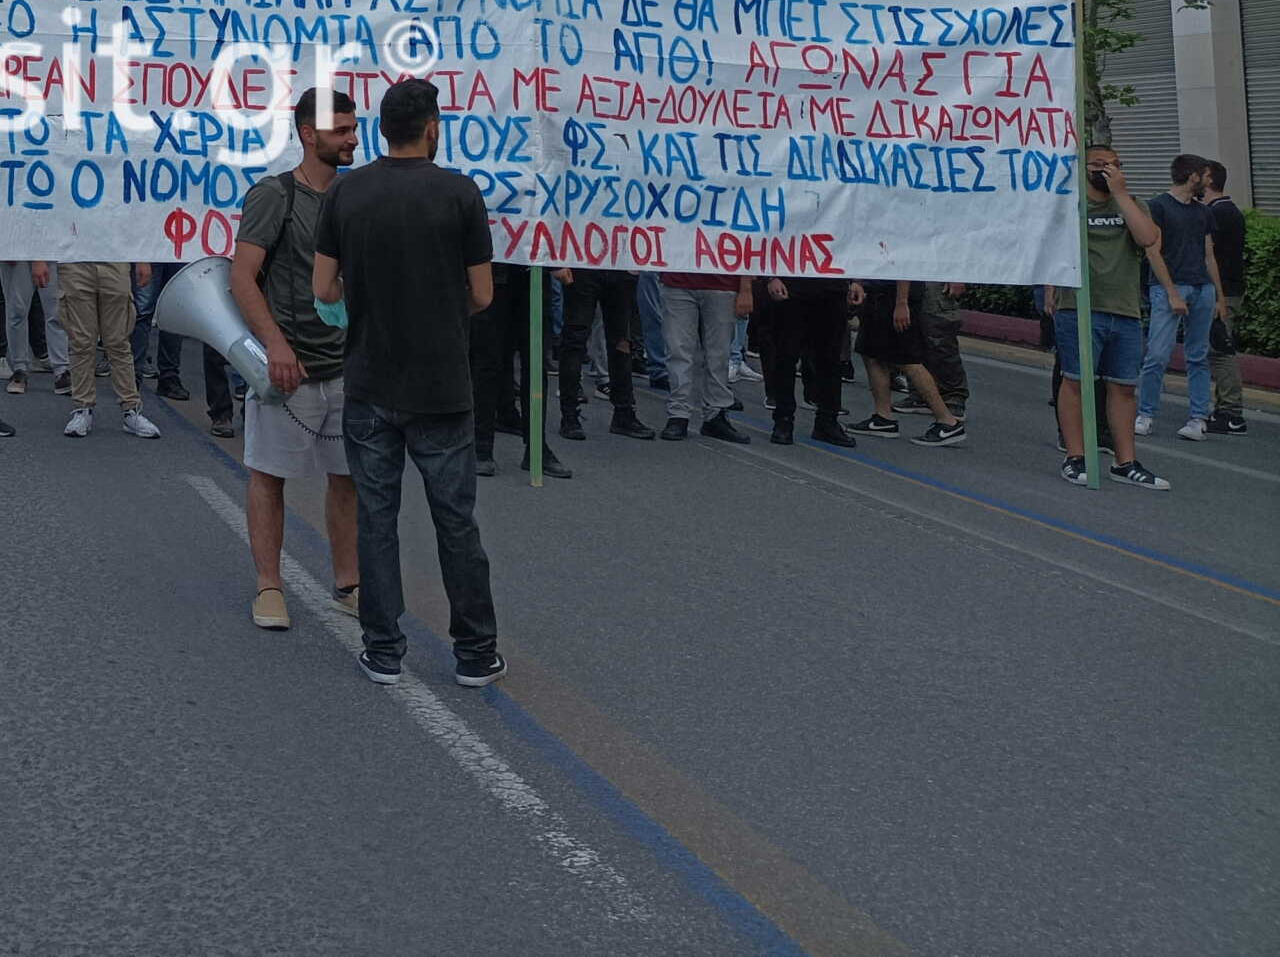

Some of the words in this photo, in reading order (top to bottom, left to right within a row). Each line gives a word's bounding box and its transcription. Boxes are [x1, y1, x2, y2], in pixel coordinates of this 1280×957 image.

[72, 8, 97, 53] Η
[121, 5, 379, 67] ΑΣΤΥΝΟΜΙΑ
[409, 16, 502, 61] ΑΠΟ
[533, 18, 584, 66] ΤΟ
[963, 50, 1053, 102] ΓΙΑ
[114, 61, 300, 110] ΣΠΟΥΔΕΣ
[330, 69, 497, 112] ΠΤΥΙΑ
[513, 67, 561, 113] ΜΕ
[809, 95, 856, 137] ΜΕ
[71, 159, 104, 209] Ο
[123, 158, 267, 209] ΝΟΜΟΣ
[80, 110, 128, 155] ΤΑ
[149, 110, 265, 158] ΧΕΡΙΑ
[638, 130, 706, 182] ΚΑΙ
[713, 132, 772, 177] ΤΙΣ
[787, 133, 996, 193] ΔΙΑΔΙΚΑΣΙΕΣ
[996, 148, 1077, 195] ΤΟΥΣ
[163, 206, 243, 260] ΦΟ
[488, 216, 669, 268] ΥΛΛΟΓΟΙ
[695, 226, 846, 276] ΑΘΗΝΑΣ
